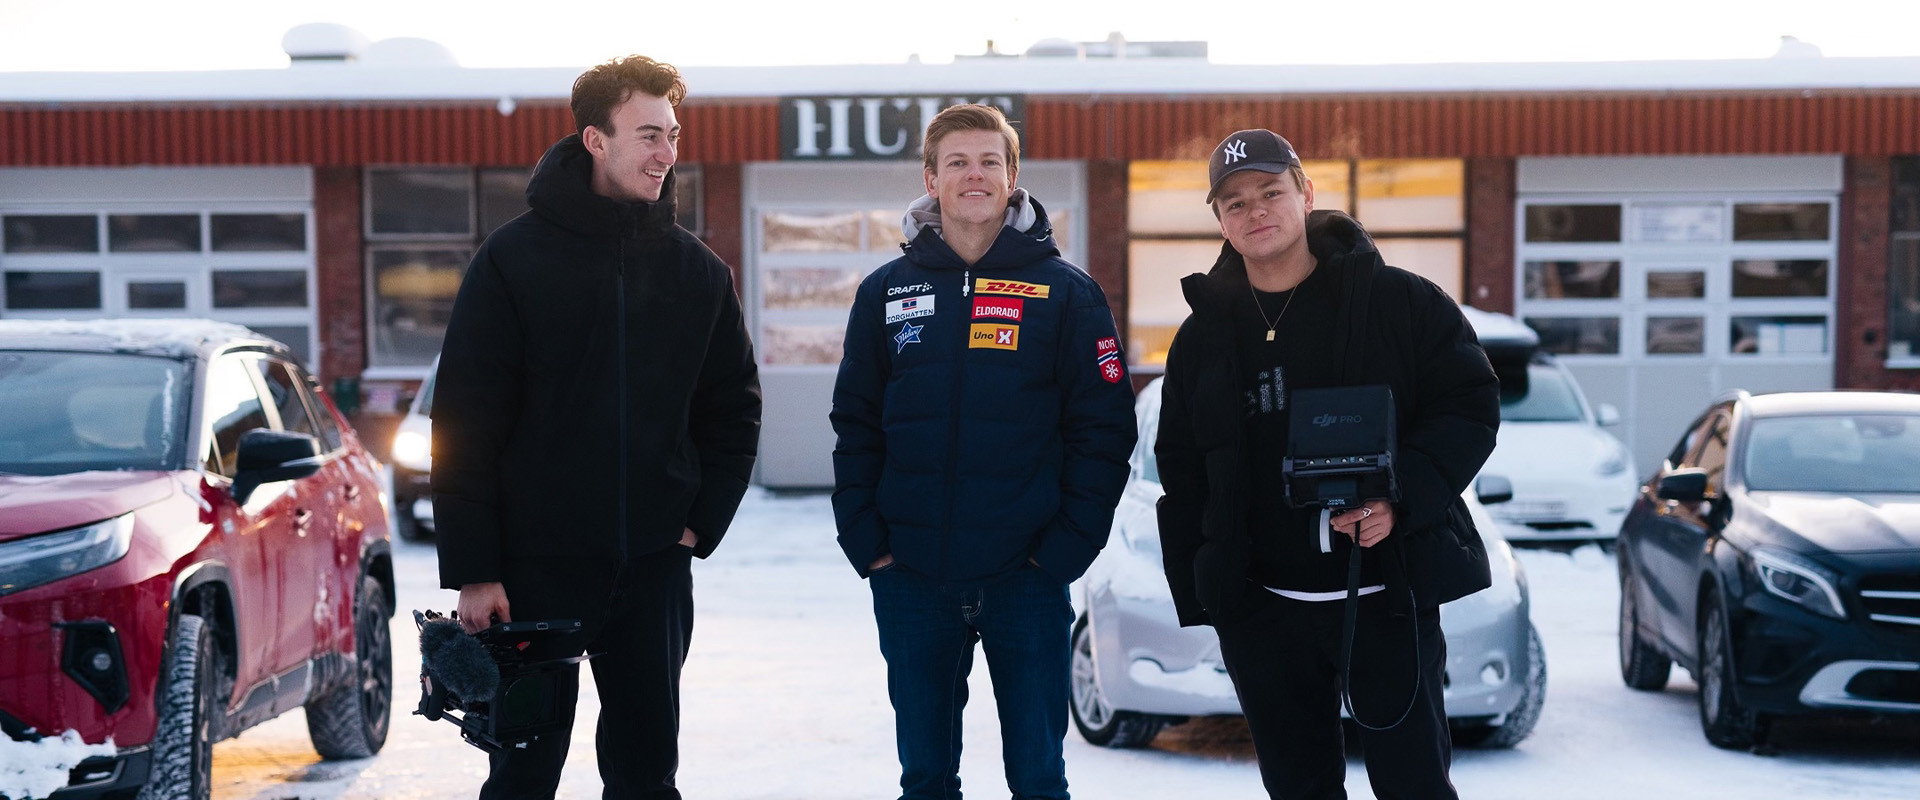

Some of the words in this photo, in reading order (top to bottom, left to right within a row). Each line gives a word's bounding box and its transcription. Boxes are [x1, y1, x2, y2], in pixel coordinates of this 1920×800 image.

[887, 284, 923, 296] CRAFT
[985, 282, 1038, 295] DHL
[886, 308, 934, 322] TORGHATTEN
[975, 306, 1019, 319] ELDORADO
[973, 331, 995, 340] Uno
[997, 330, 1013, 344] X
[1098, 339, 1116, 350] NOR
[1340, 415, 1362, 423] PRO
